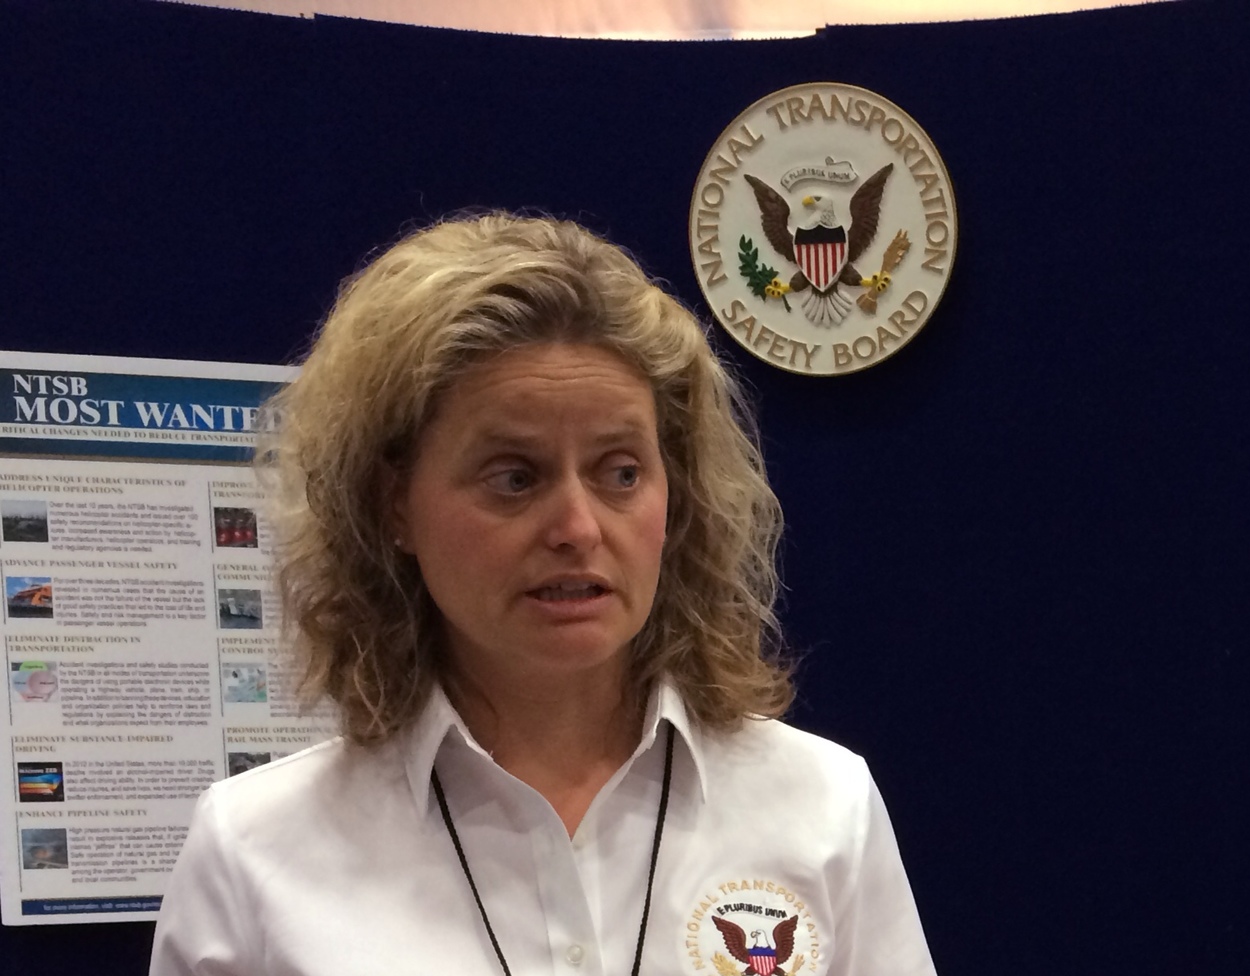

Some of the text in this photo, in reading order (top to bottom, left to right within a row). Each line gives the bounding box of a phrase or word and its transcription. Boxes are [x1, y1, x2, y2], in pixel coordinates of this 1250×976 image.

[697, 93, 949, 289] NATIONAL TRANSPORTATION
[721, 290, 929, 369] SAFETY BOARD
[13, 374, 88, 396] NTSB
[13, 396, 124, 426] MOST
[2, 426, 39, 435] RITICAL
[134, 431, 147, 439] TO
[724, 902, 763, 915] PLURIBUS
[685, 879, 820, 973] NATIONAL TRANSPORTATION
